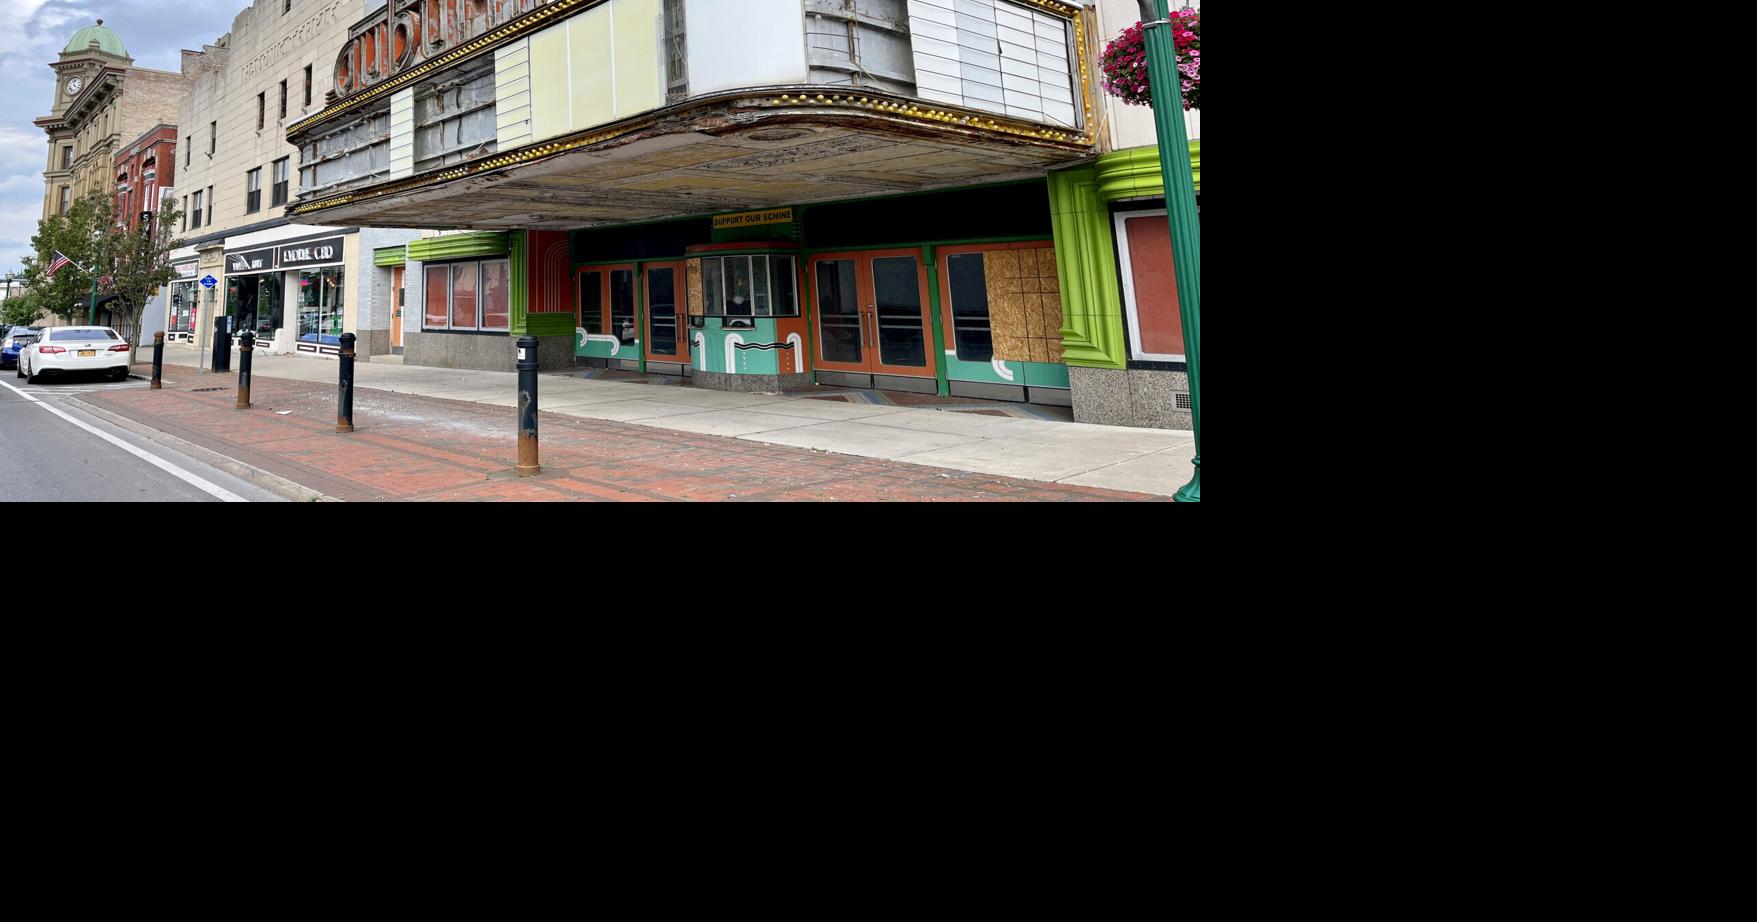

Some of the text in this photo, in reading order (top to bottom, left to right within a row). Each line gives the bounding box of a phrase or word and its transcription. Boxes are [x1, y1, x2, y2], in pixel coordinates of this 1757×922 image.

[714, 210, 791, 226] SUPPORT OUR SCHINE
